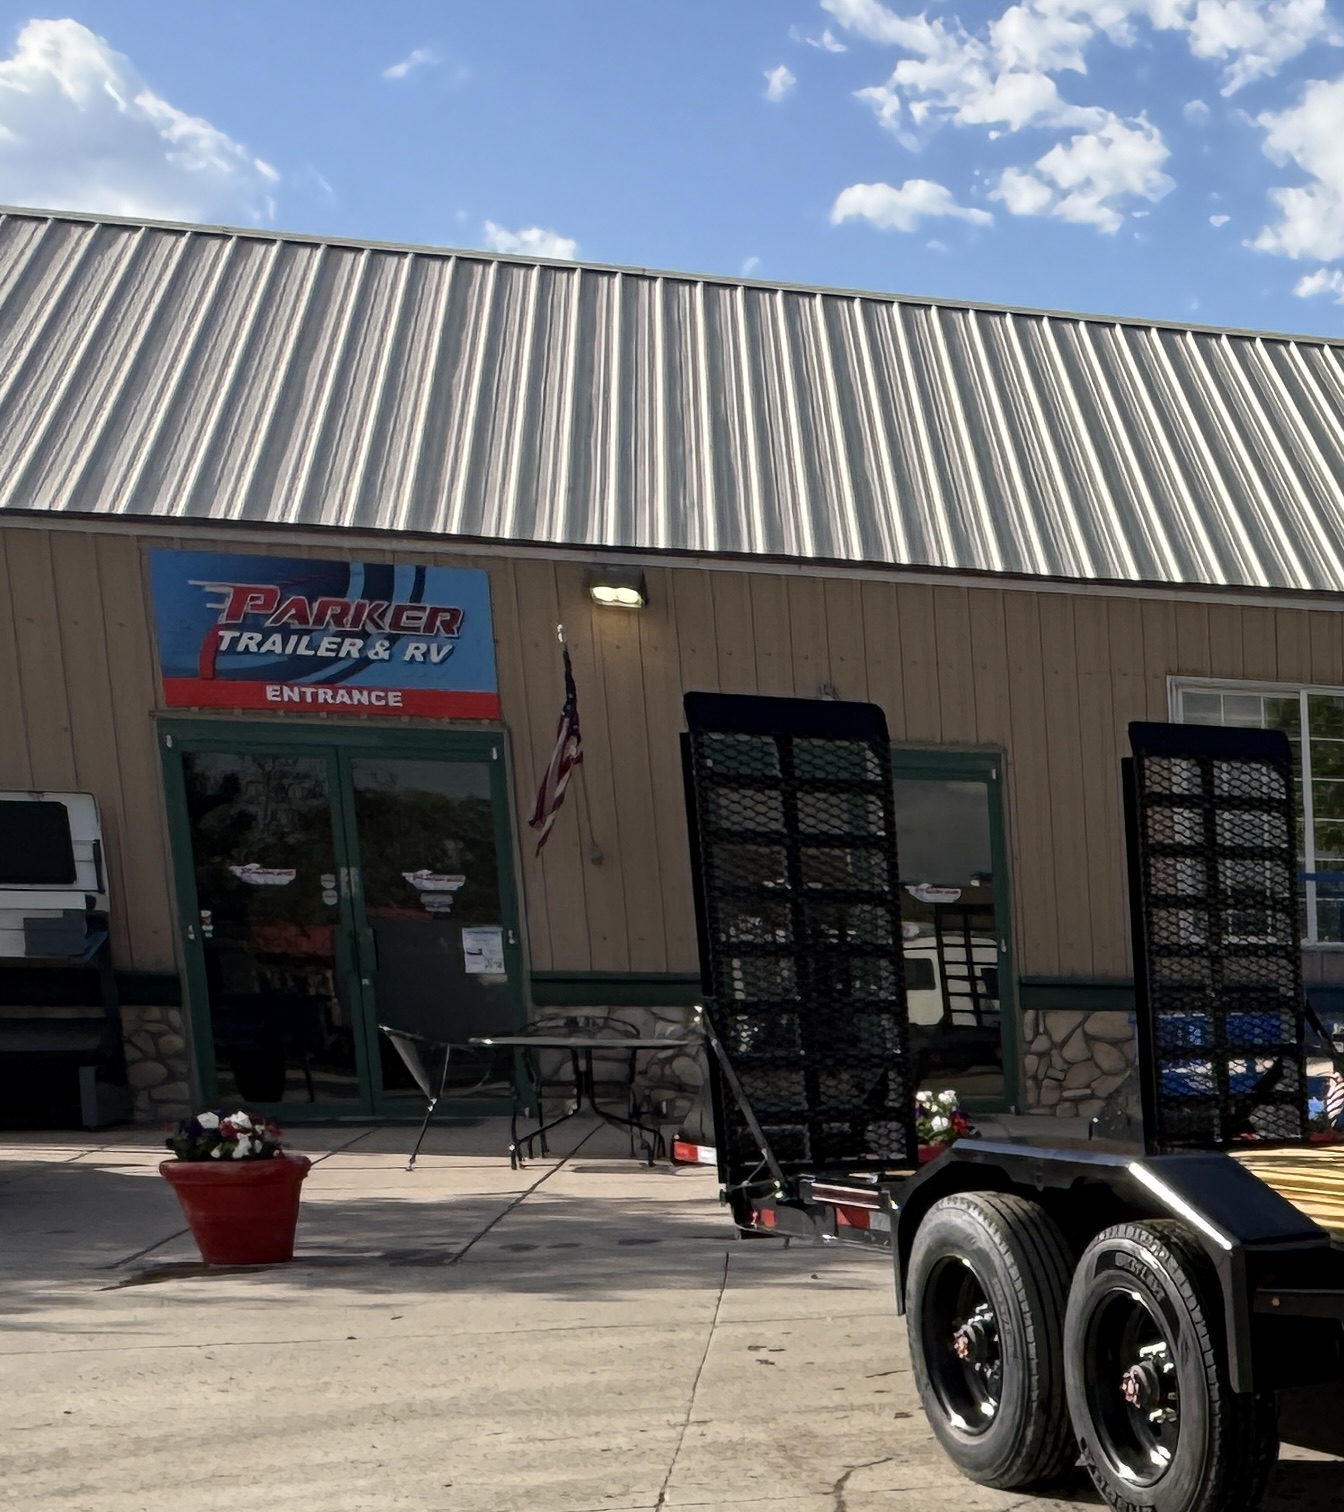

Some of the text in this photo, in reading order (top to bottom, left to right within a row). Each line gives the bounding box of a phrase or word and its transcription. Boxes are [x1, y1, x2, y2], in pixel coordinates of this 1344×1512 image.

[217, 584, 464, 637] PARKER
[217, 630, 454, 664] TRAILER & RV
[265, 685, 404, 708] ENTRANCE
